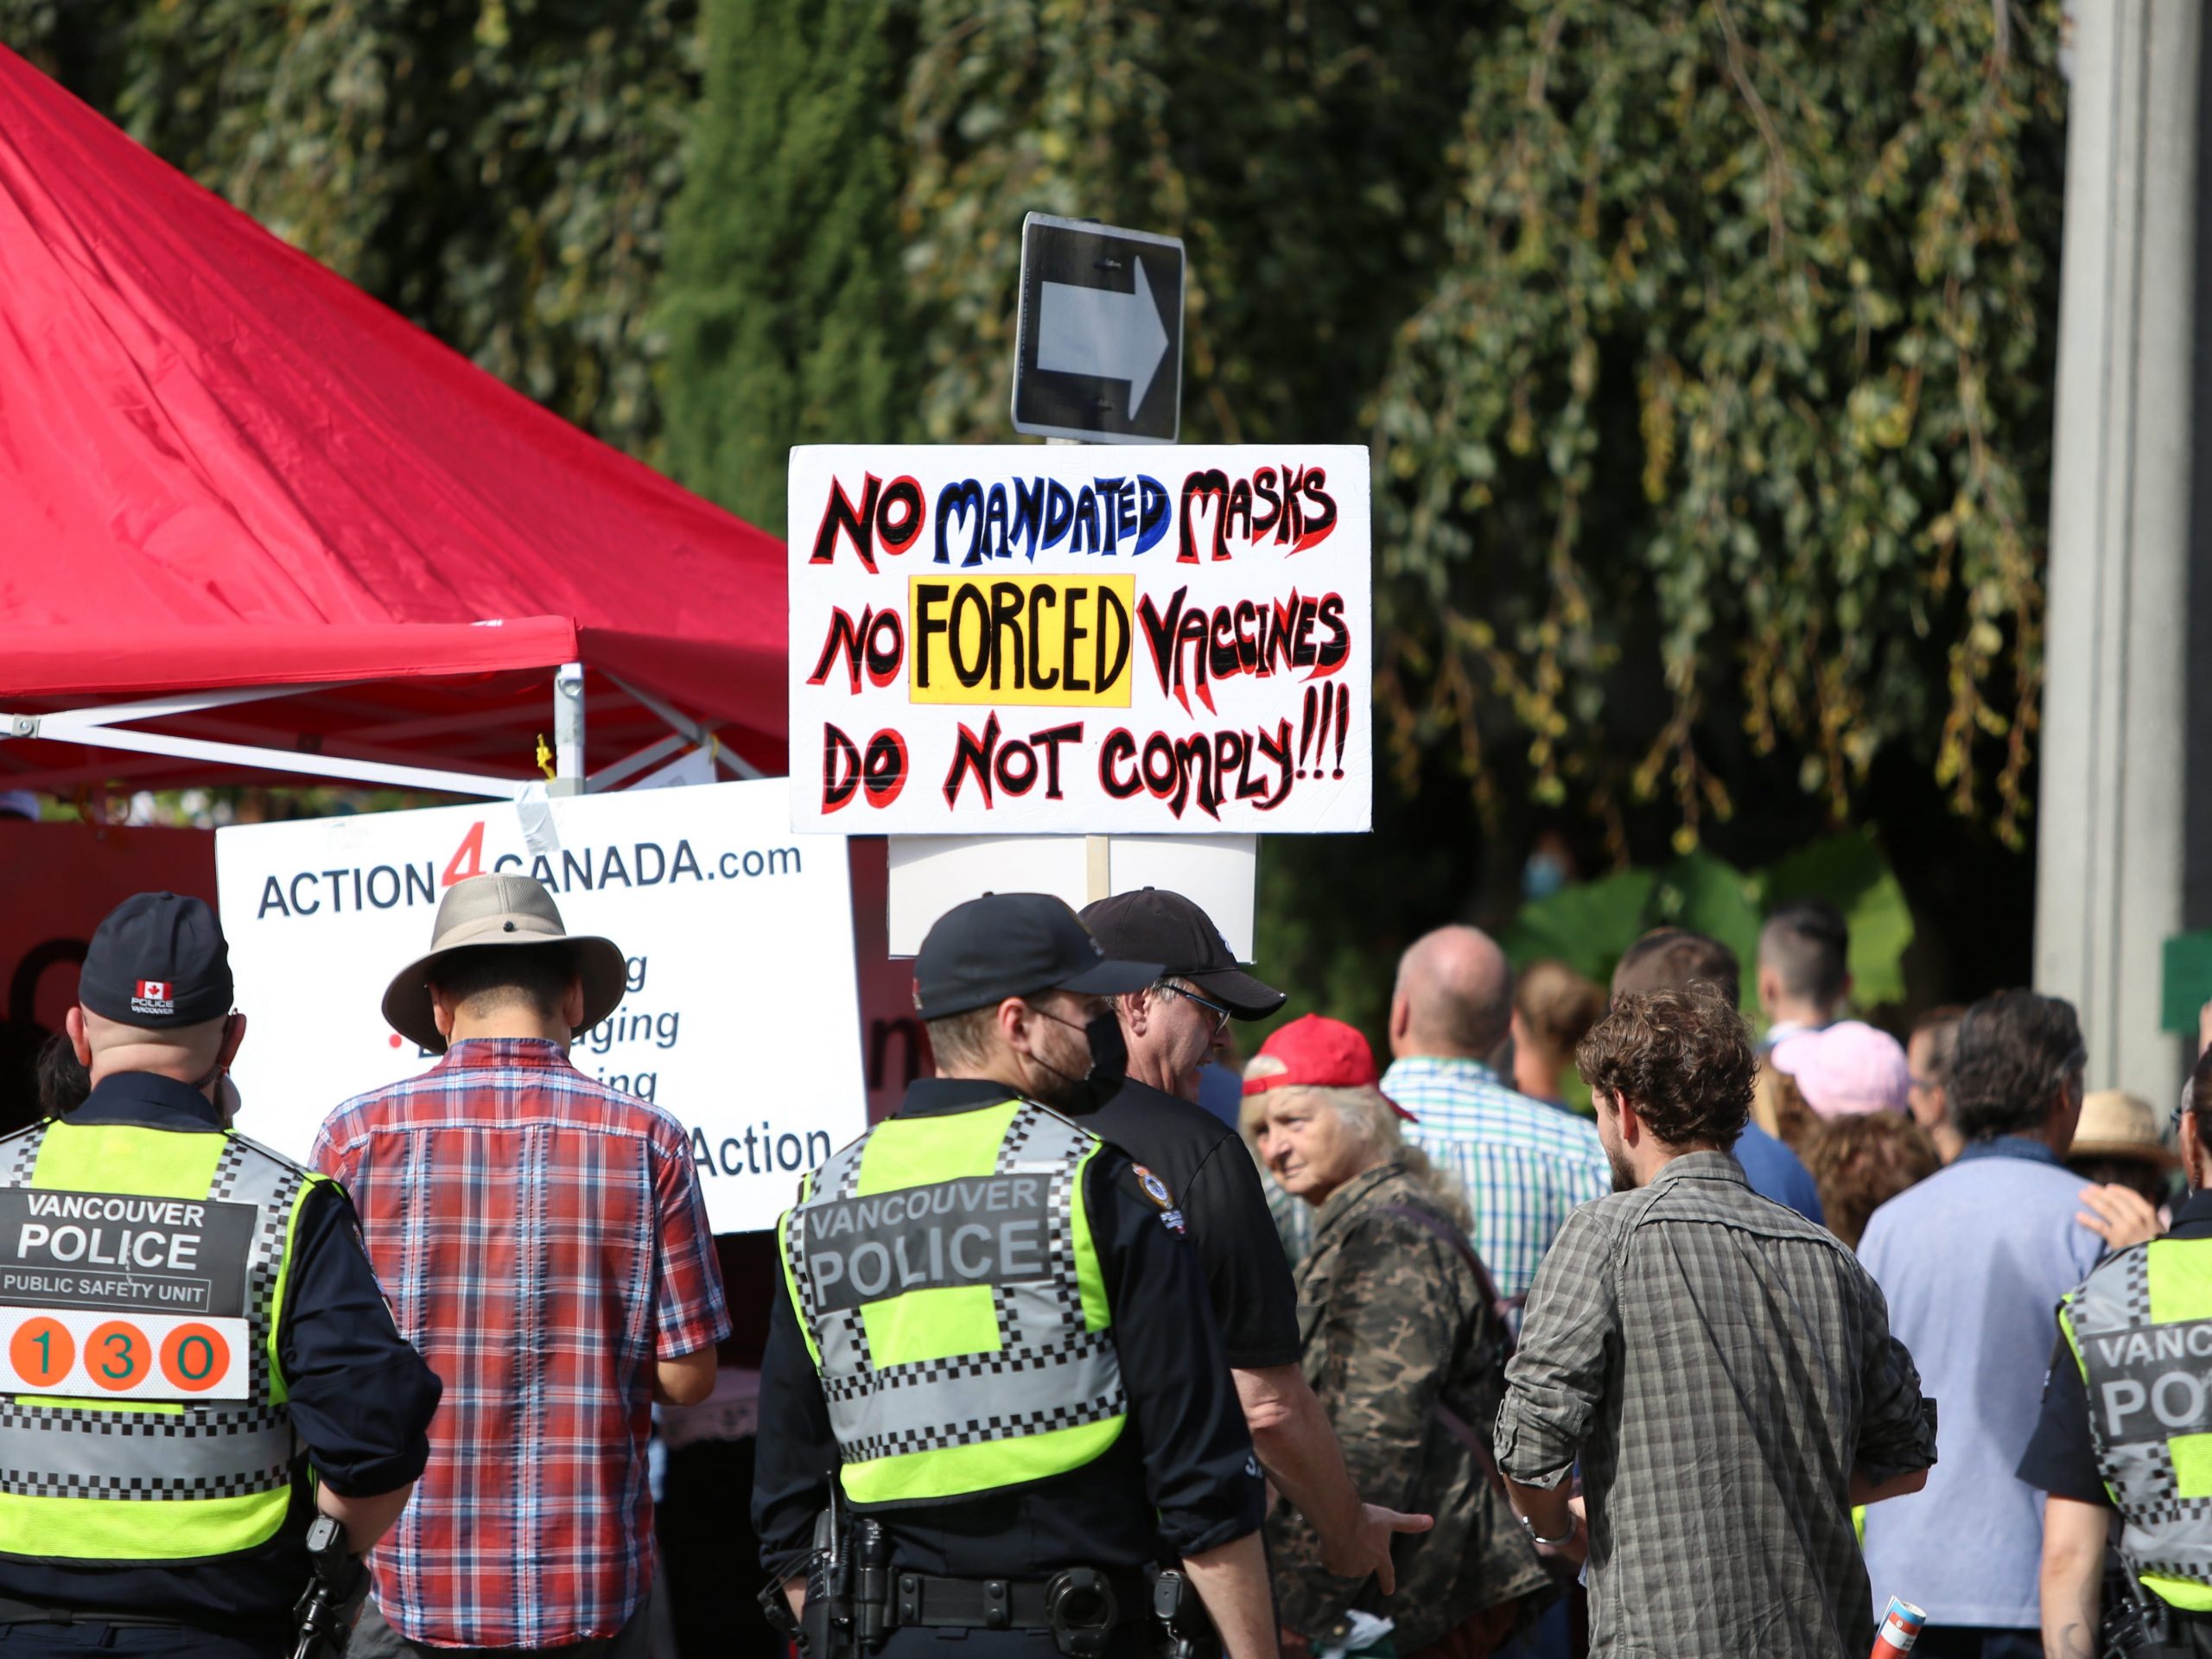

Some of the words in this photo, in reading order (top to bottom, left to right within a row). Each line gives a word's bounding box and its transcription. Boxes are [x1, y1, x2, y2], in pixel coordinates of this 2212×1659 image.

[809, 471, 926, 574] NO
[933, 474, 1172, 568] MANDATED
[1176, 463, 1338, 564] MASKS
[806, 602, 906, 694] NO
[916, 582, 1131, 694] FORCED
[1135, 585, 1351, 719] VACCINES
[821, 721, 908, 815] DO
[942, 709, 1085, 811] NOT
[1098, 680, 1351, 822] COMPLY!!!
[130, 996, 174, 1007] POLICE
[692, 1122, 831, 1178] Action
[27, 1194, 206, 1228] VANCOUVER
[810, 1178, 1038, 1241] VANCOUVER
[16, 1224, 201, 1271] POLICE
[810, 1218, 1044, 1307] POLICE
[3, 1274, 73, 1294] PUBLIC
[78, 1280, 155, 1299] SAFETY
[158, 1285, 206, 1303] UNIT
